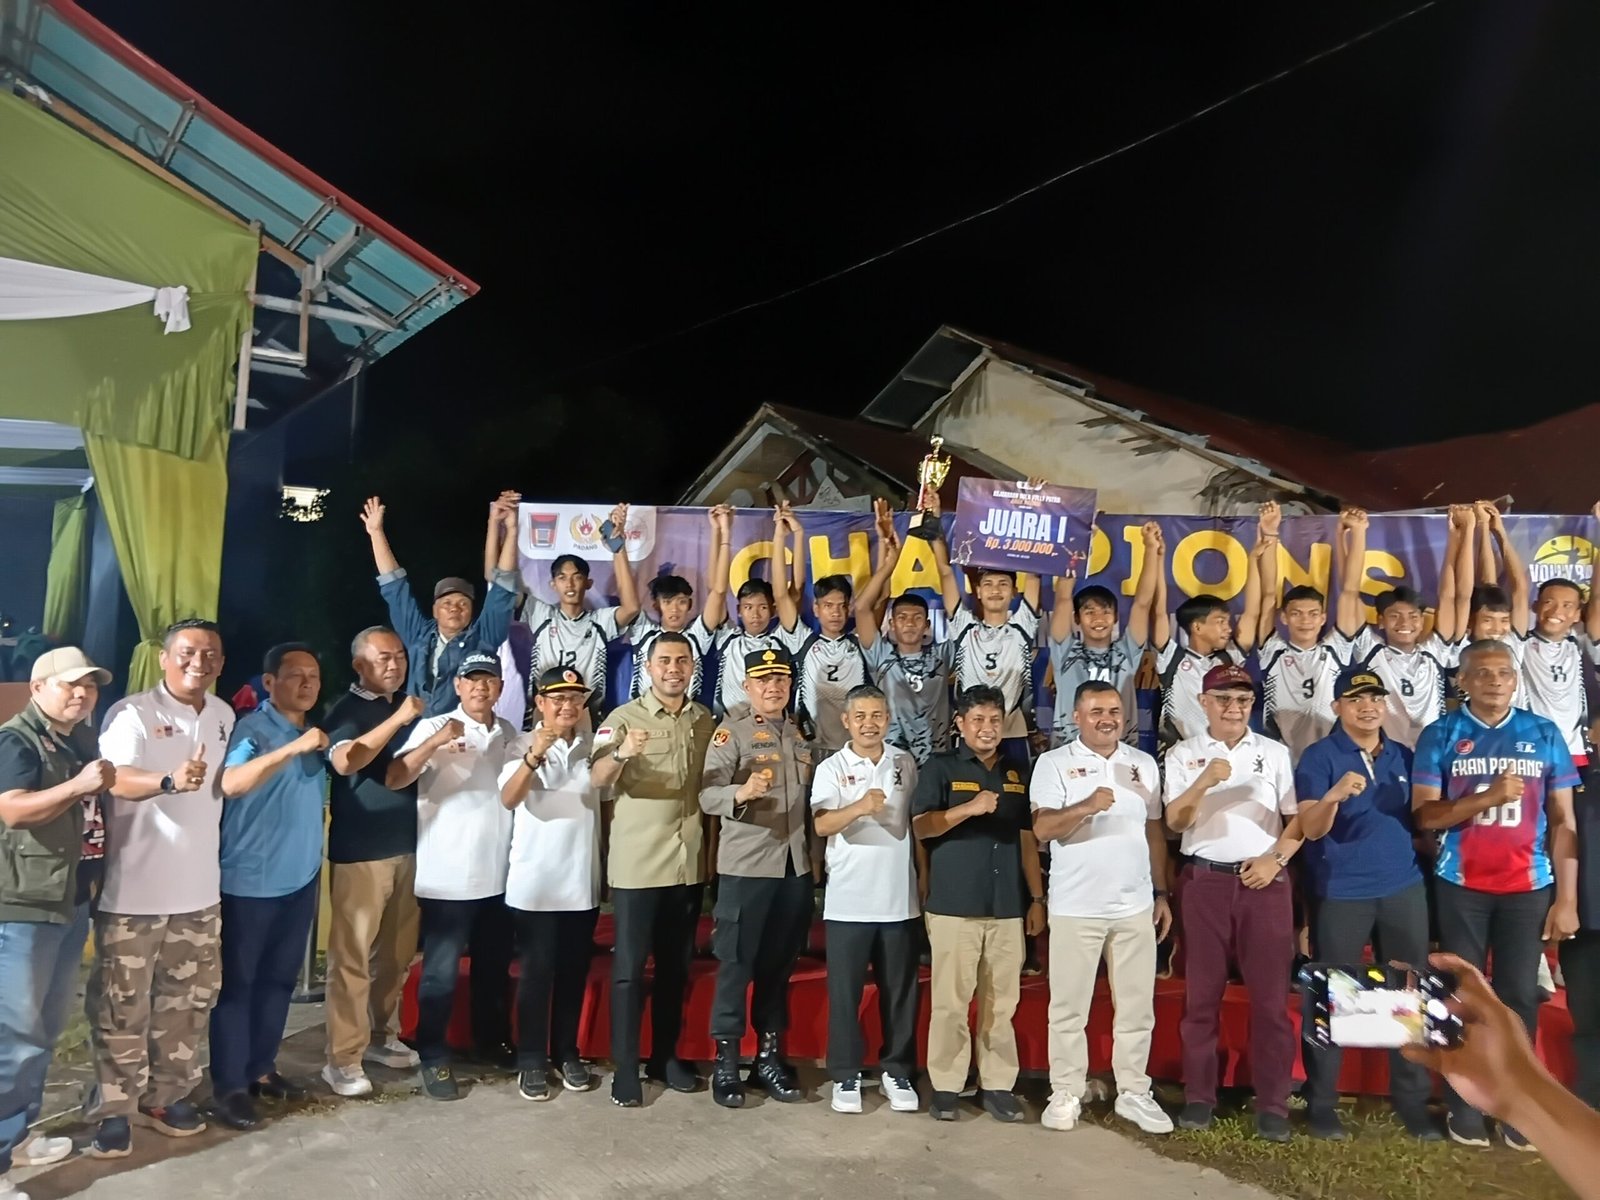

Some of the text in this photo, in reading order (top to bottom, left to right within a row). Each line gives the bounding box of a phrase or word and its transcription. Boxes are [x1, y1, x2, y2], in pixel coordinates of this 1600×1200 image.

[979, 508, 1068, 543] JUARA I
[985, 536, 1001, 551] Rp.
[729, 525, 1406, 624] CHAIONS
[559, 650, 577, 669] 12
[985, 653, 997, 670] 5
[827, 664, 838, 682] 2
[1088, 667, 1110, 683] 14
[1303, 678, 1315, 699] 9
[1400, 678, 1415, 697] 8
